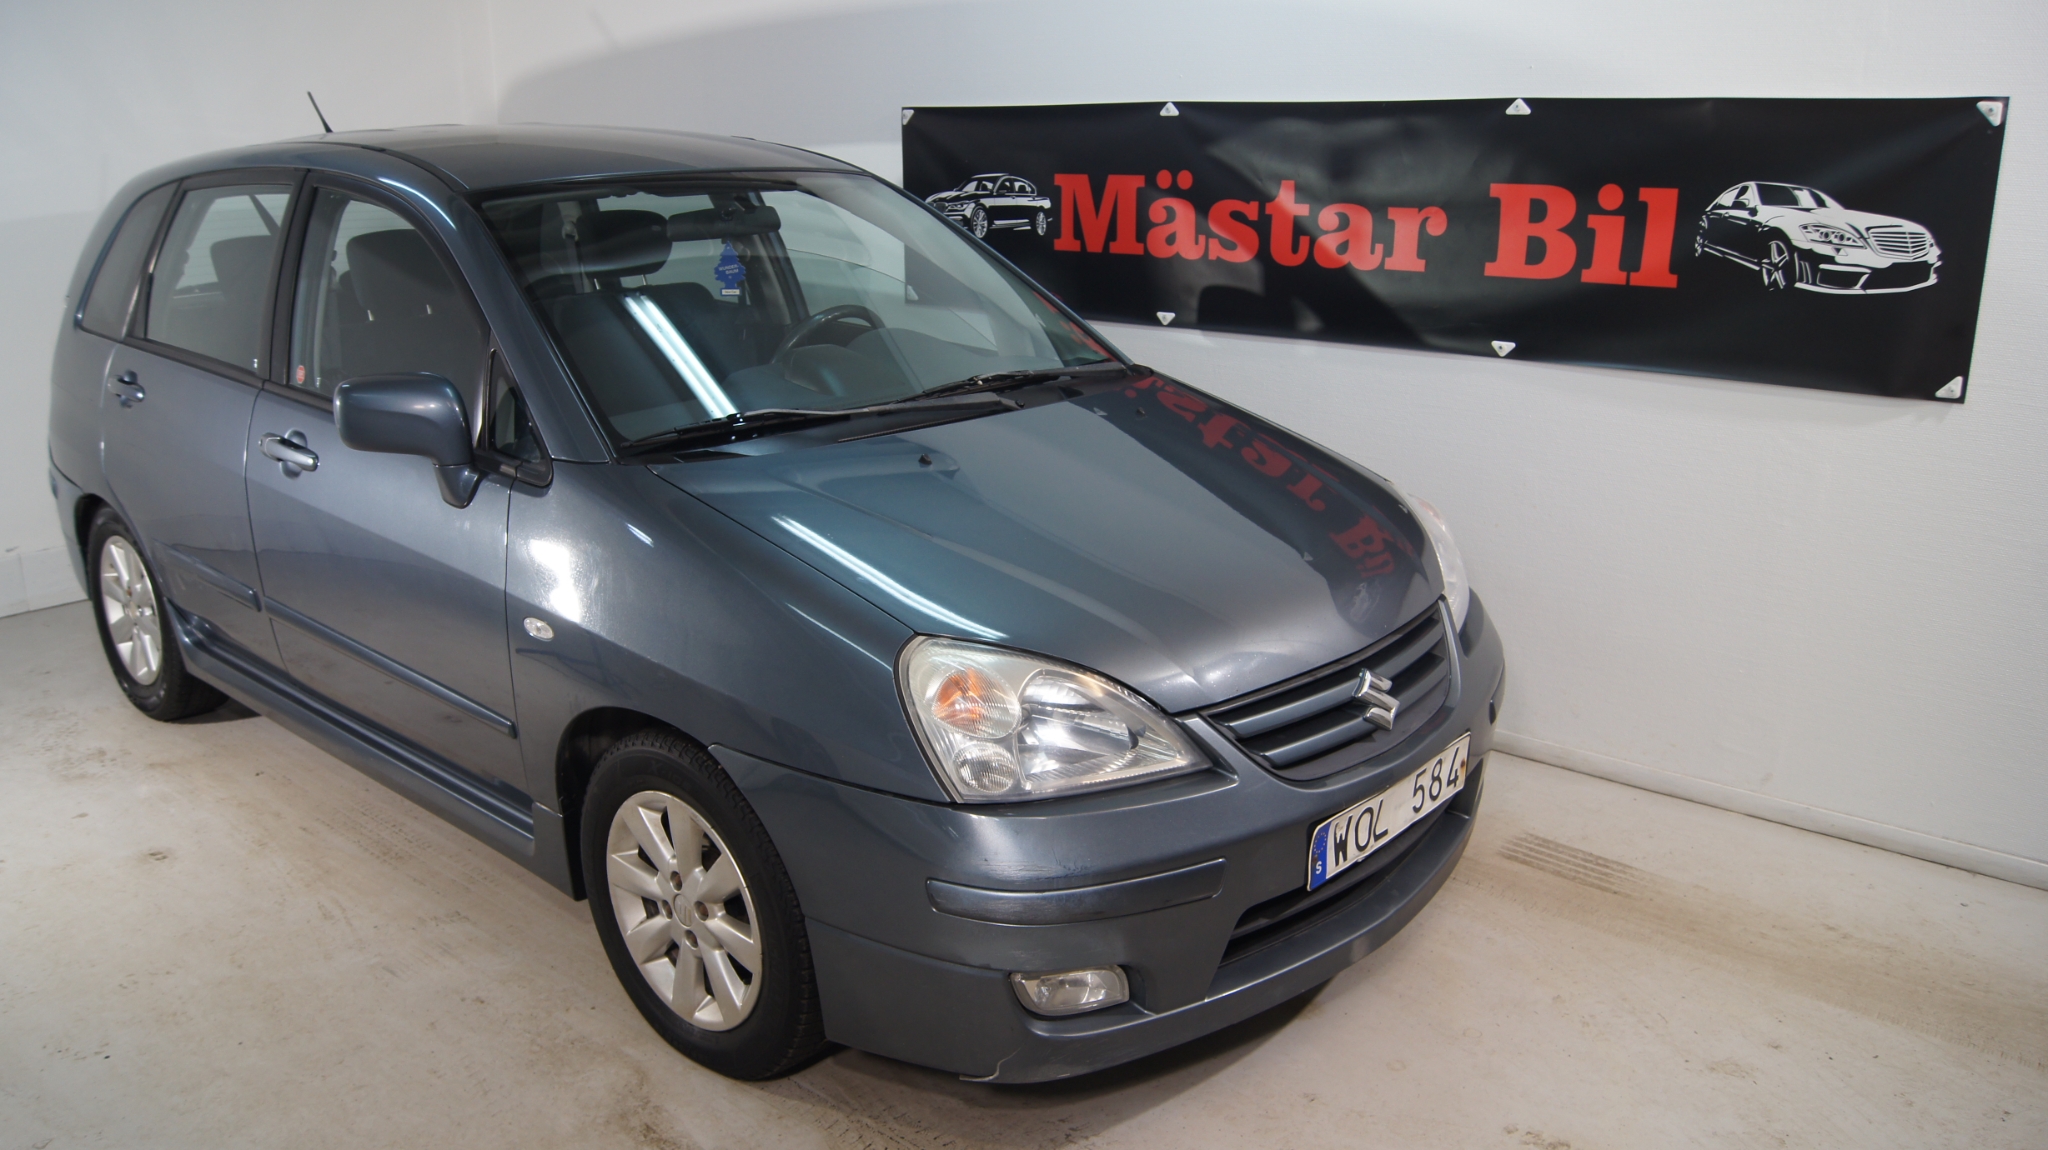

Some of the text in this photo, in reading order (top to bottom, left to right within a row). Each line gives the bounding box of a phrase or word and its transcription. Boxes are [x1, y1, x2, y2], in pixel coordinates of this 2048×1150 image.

[1053, 169, 1680, 289] Mästar Bil
[1315, 860, 1323, 874] S
[1333, 746, 1460, 868] WOL 584
